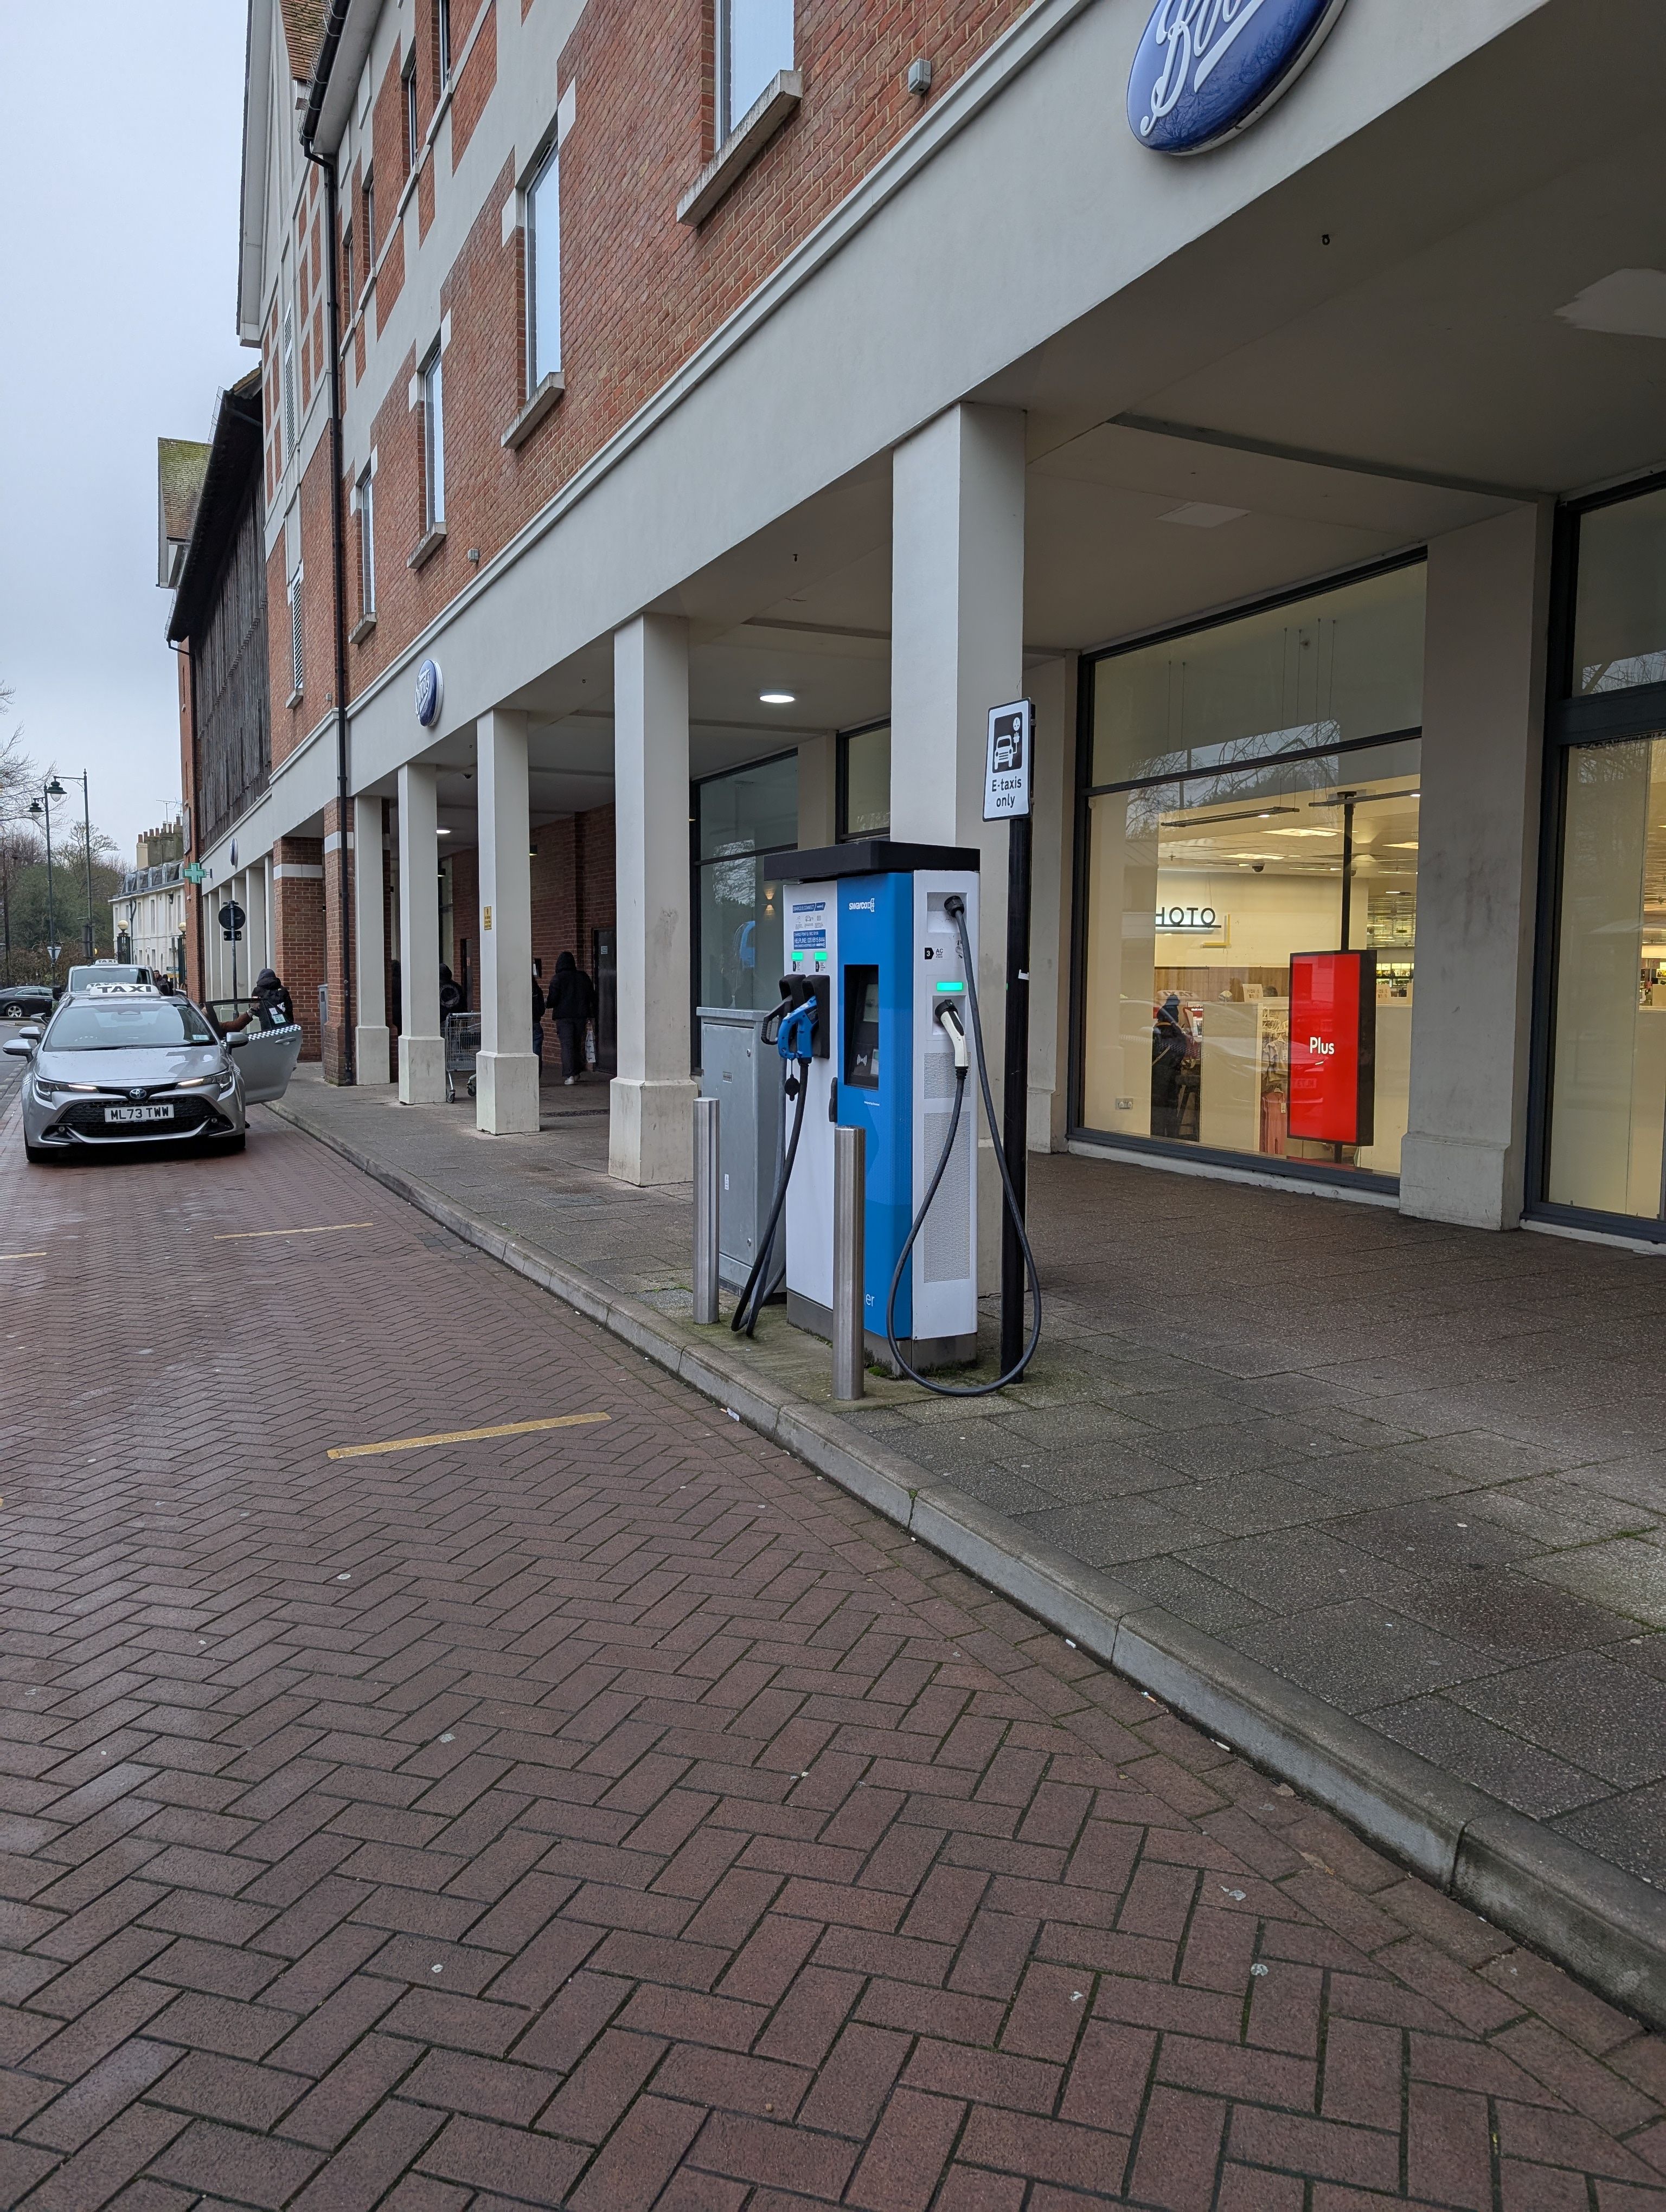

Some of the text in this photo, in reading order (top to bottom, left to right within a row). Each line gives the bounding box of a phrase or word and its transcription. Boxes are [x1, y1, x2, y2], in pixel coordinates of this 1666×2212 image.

[991, 776, 1022, 792] E-taxis
[996, 793, 1015, 808] only
[1156, 906, 1216, 927] HOTO
[1310, 1037, 1335, 1054] Plus
[111, 1107, 169, 1120] ML73 TWW
